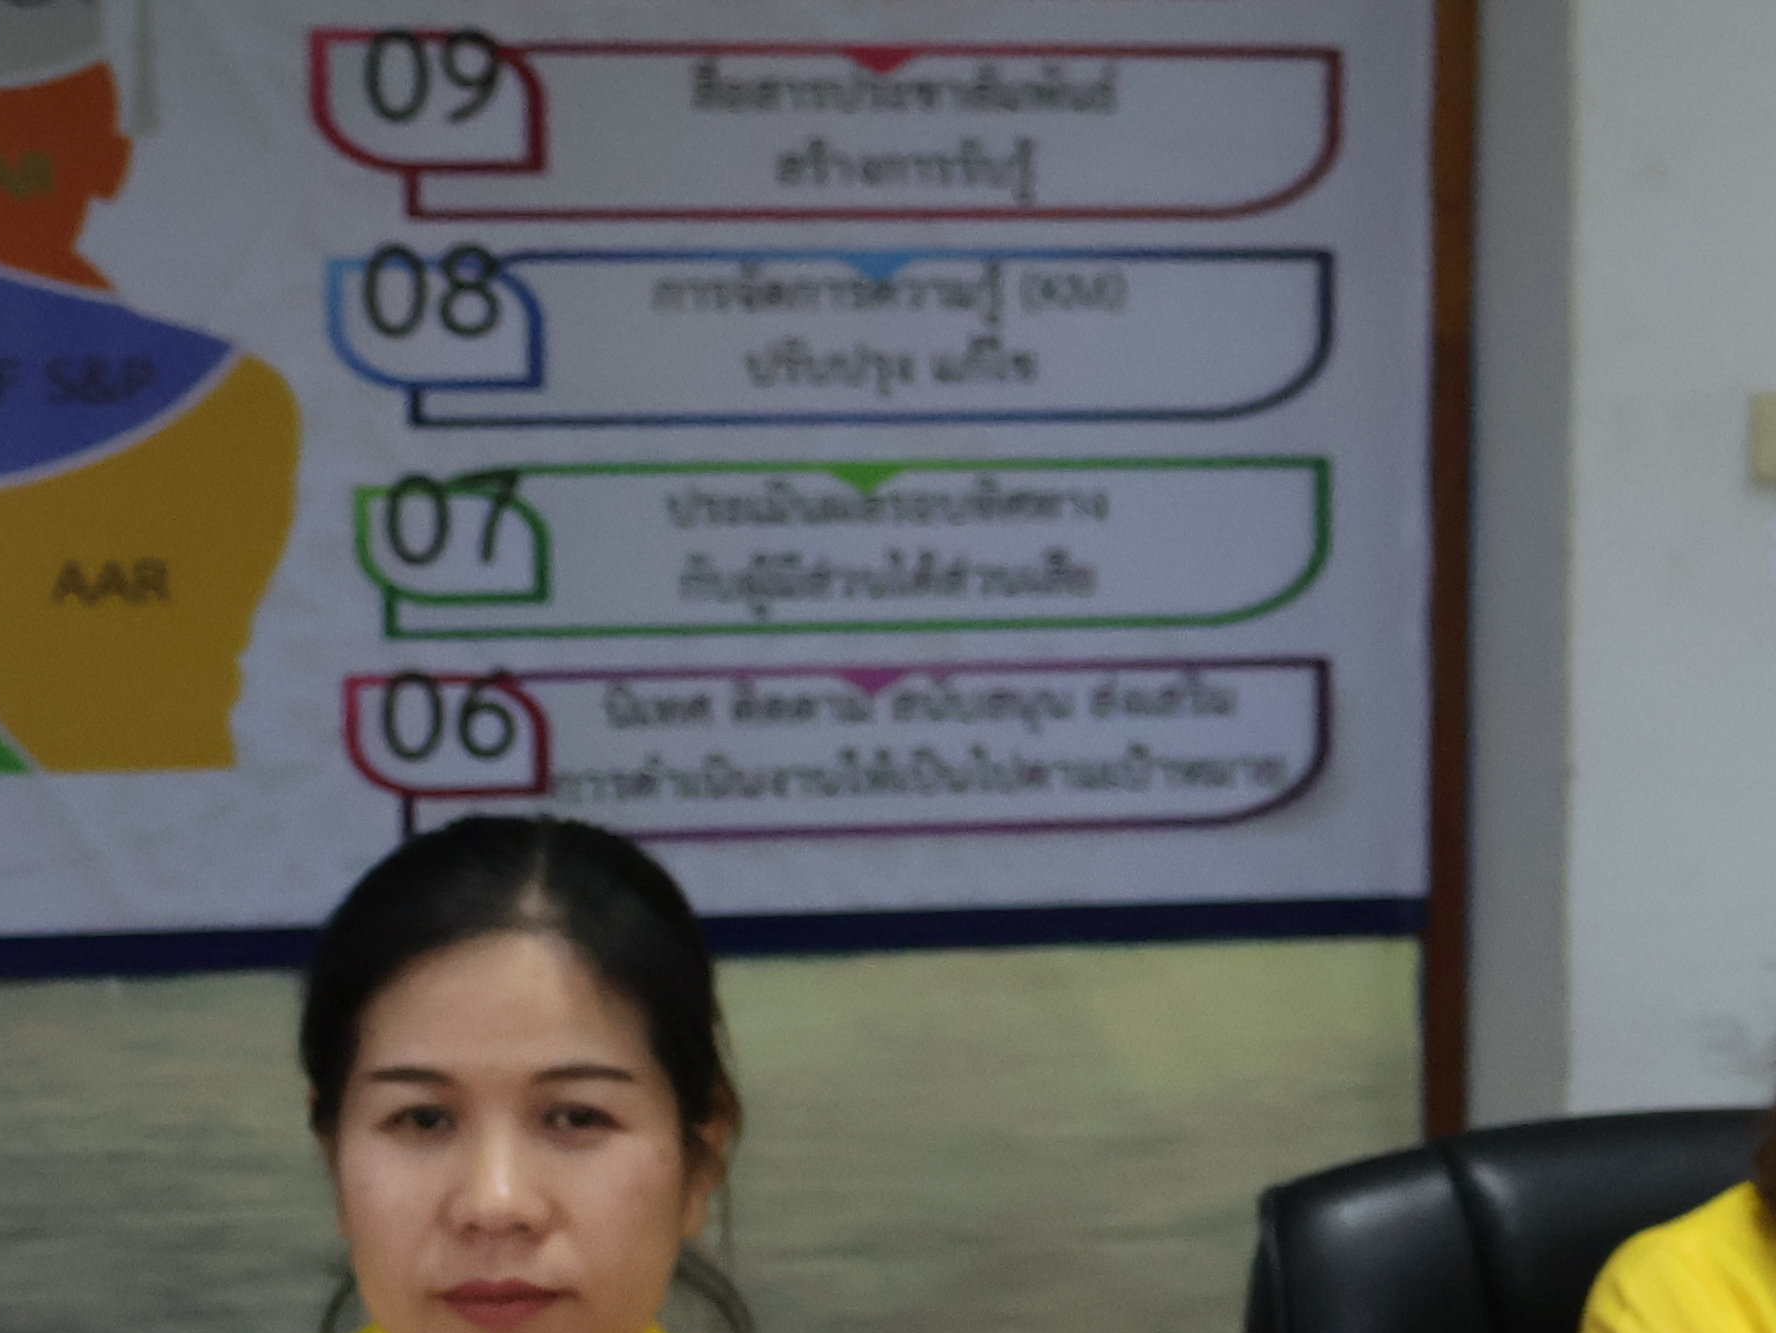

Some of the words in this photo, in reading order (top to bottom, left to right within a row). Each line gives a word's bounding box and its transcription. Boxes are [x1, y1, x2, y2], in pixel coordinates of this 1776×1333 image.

[365, 26, 499, 124] 09
[364, 241, 501, 340] 08
[42, 355, 159, 405] S&P
[744, 334, 915, 398] ปรับปรุง
[387, 471, 519, 566] 07
[52, 556, 171, 608] AAR
[382, 671, 515, 763] 06
